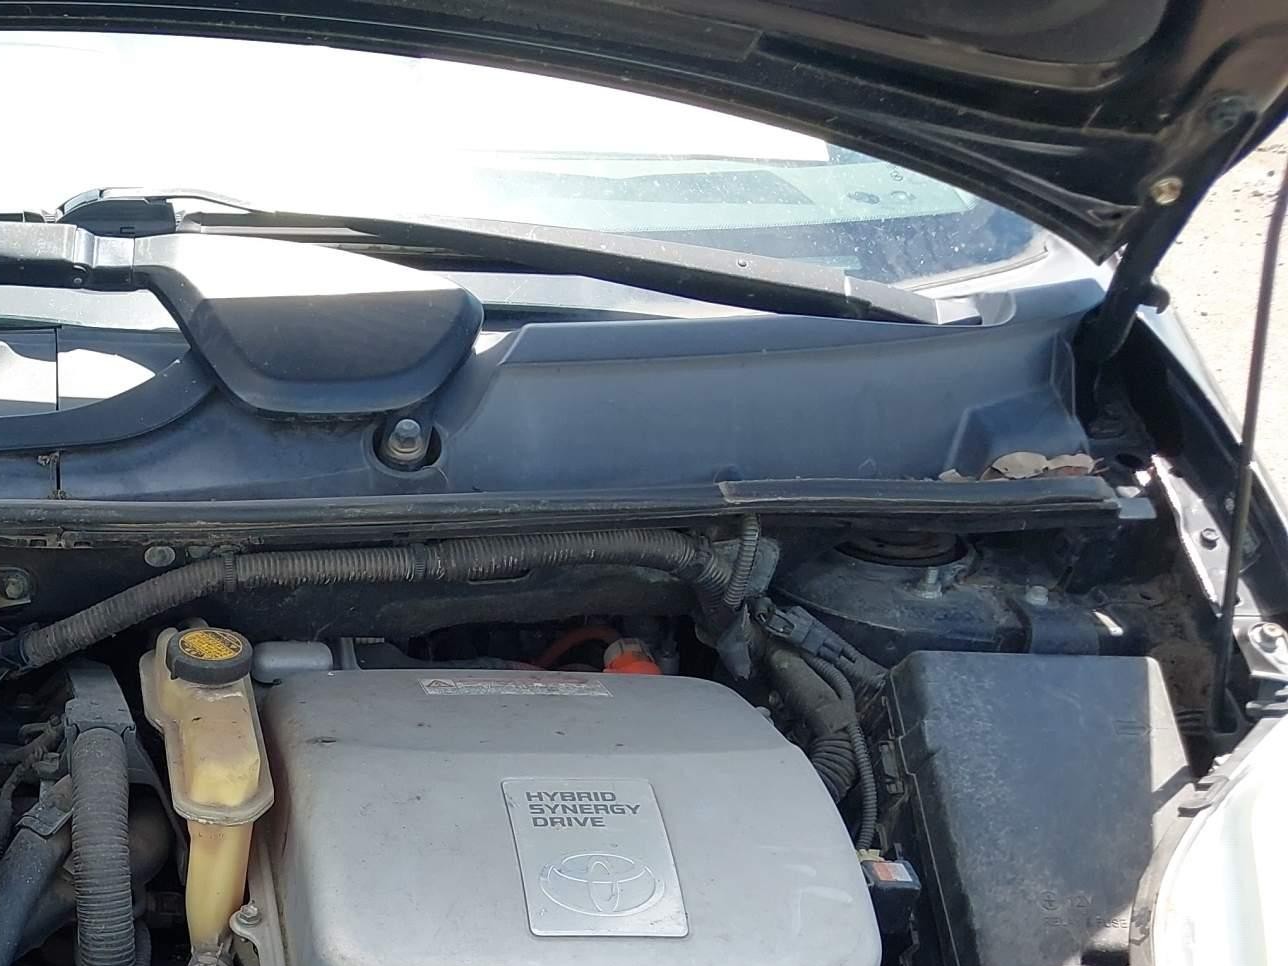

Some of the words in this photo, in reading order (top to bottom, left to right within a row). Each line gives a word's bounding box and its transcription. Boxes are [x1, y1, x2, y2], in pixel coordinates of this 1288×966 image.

[526, 791, 617, 802] HYBRID
[529, 804, 640, 815] SYNERGY
[532, 816, 606, 828] DRIVE
